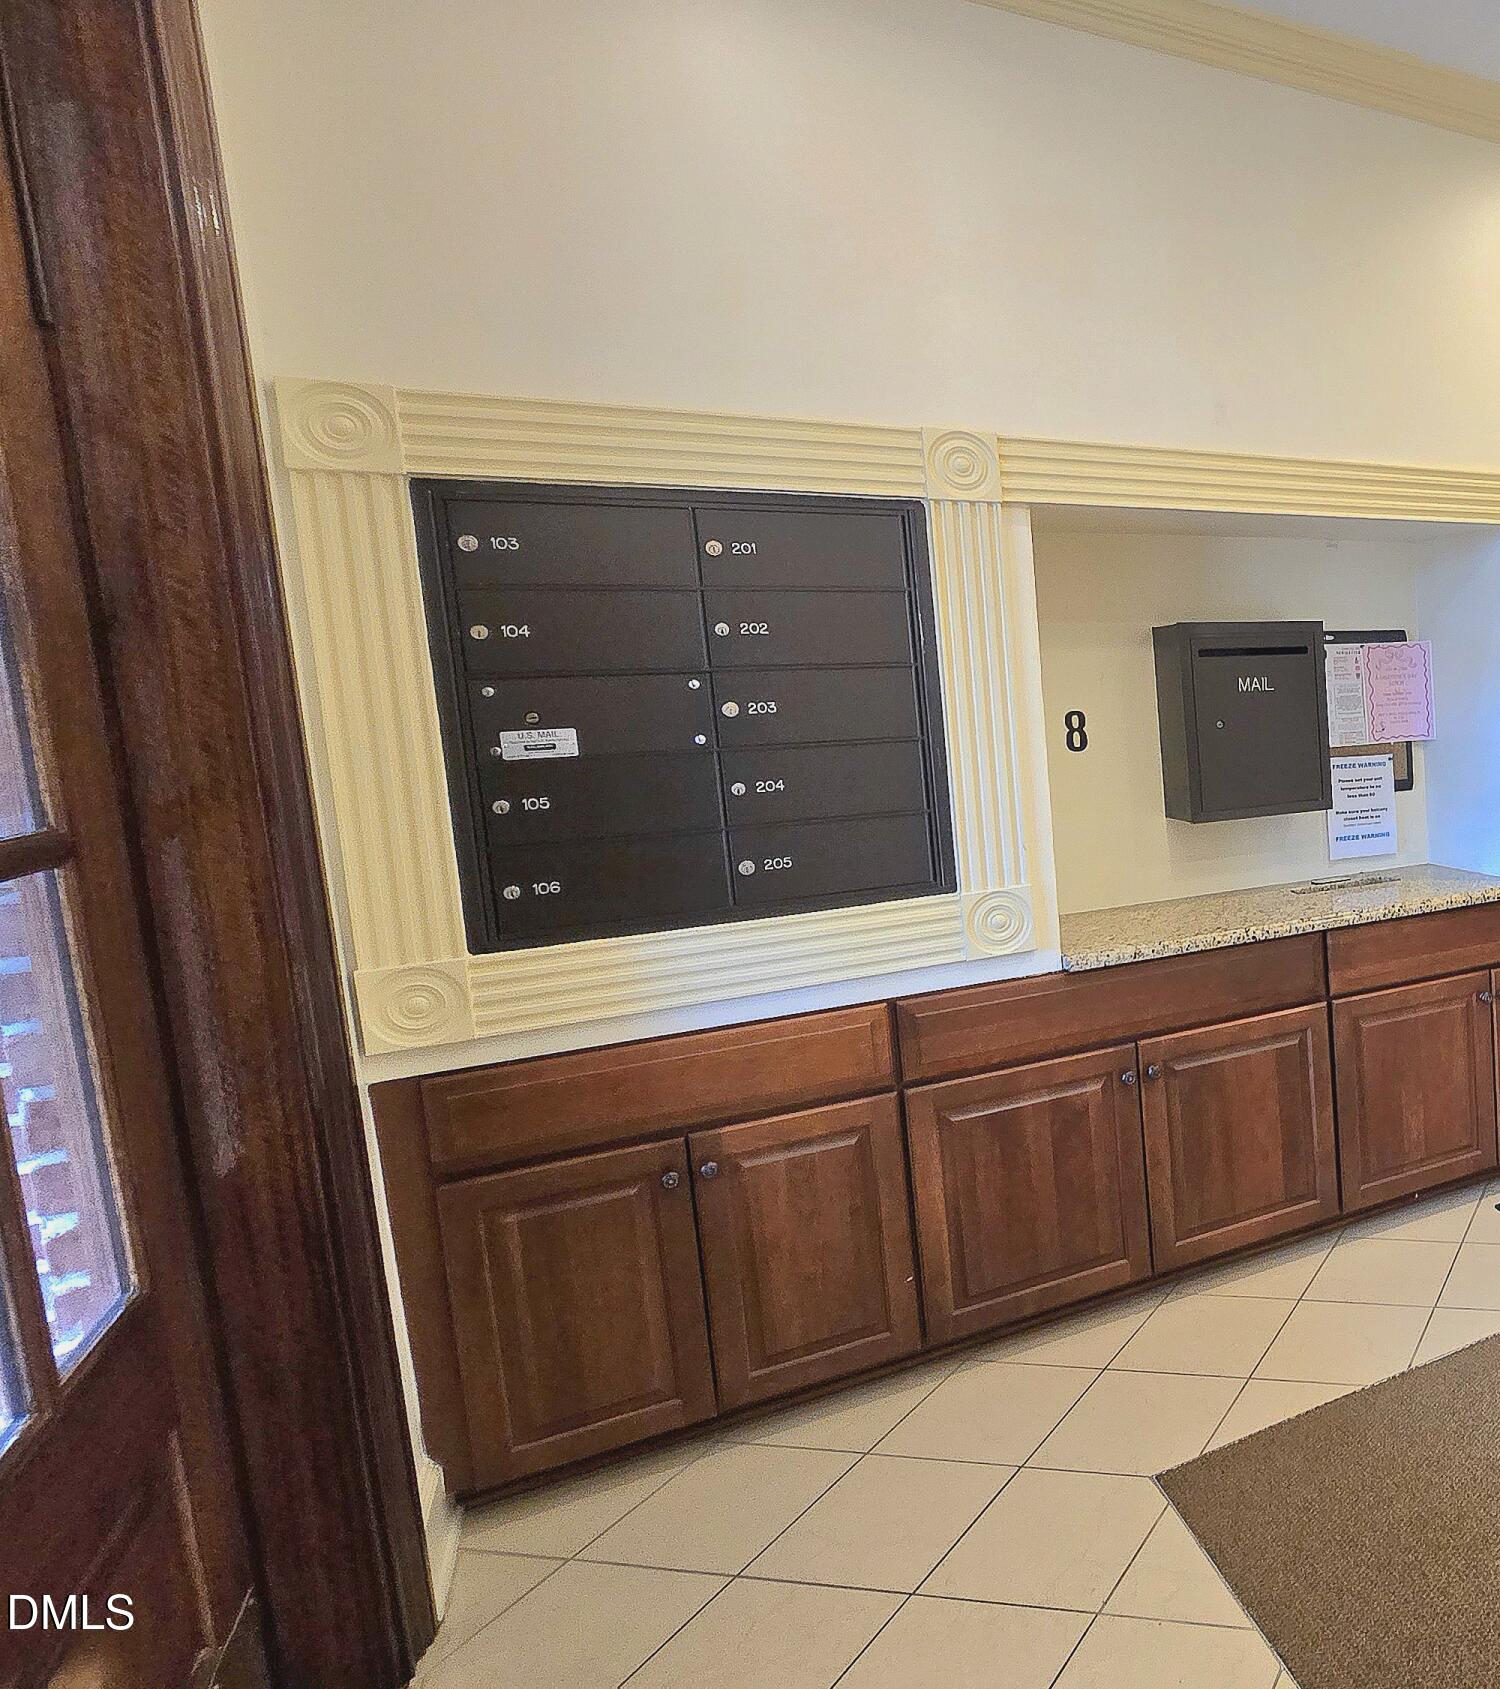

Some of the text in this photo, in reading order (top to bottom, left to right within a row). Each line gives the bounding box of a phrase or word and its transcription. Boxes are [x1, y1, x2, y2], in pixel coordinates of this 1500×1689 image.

[490, 536, 520, 550] 103
[731, 542, 757, 555] 201
[500, 624, 531, 638] 104
[739, 622, 770, 635] 202
[1238, 676, 1275, 692] MAIL
[747, 701, 777, 715] 203
[537, 730, 558, 739] MAIL
[1064, 710, 1088, 752] 8
[1332, 761, 1387, 770] FREEZE WARNING
[755, 779, 785, 793] 204
[521, 796, 551, 811] 105
[1335, 831, 1390, 843] FREEZE WARNING
[763, 856, 793, 871] 205
[532, 881, 561, 895] 106
